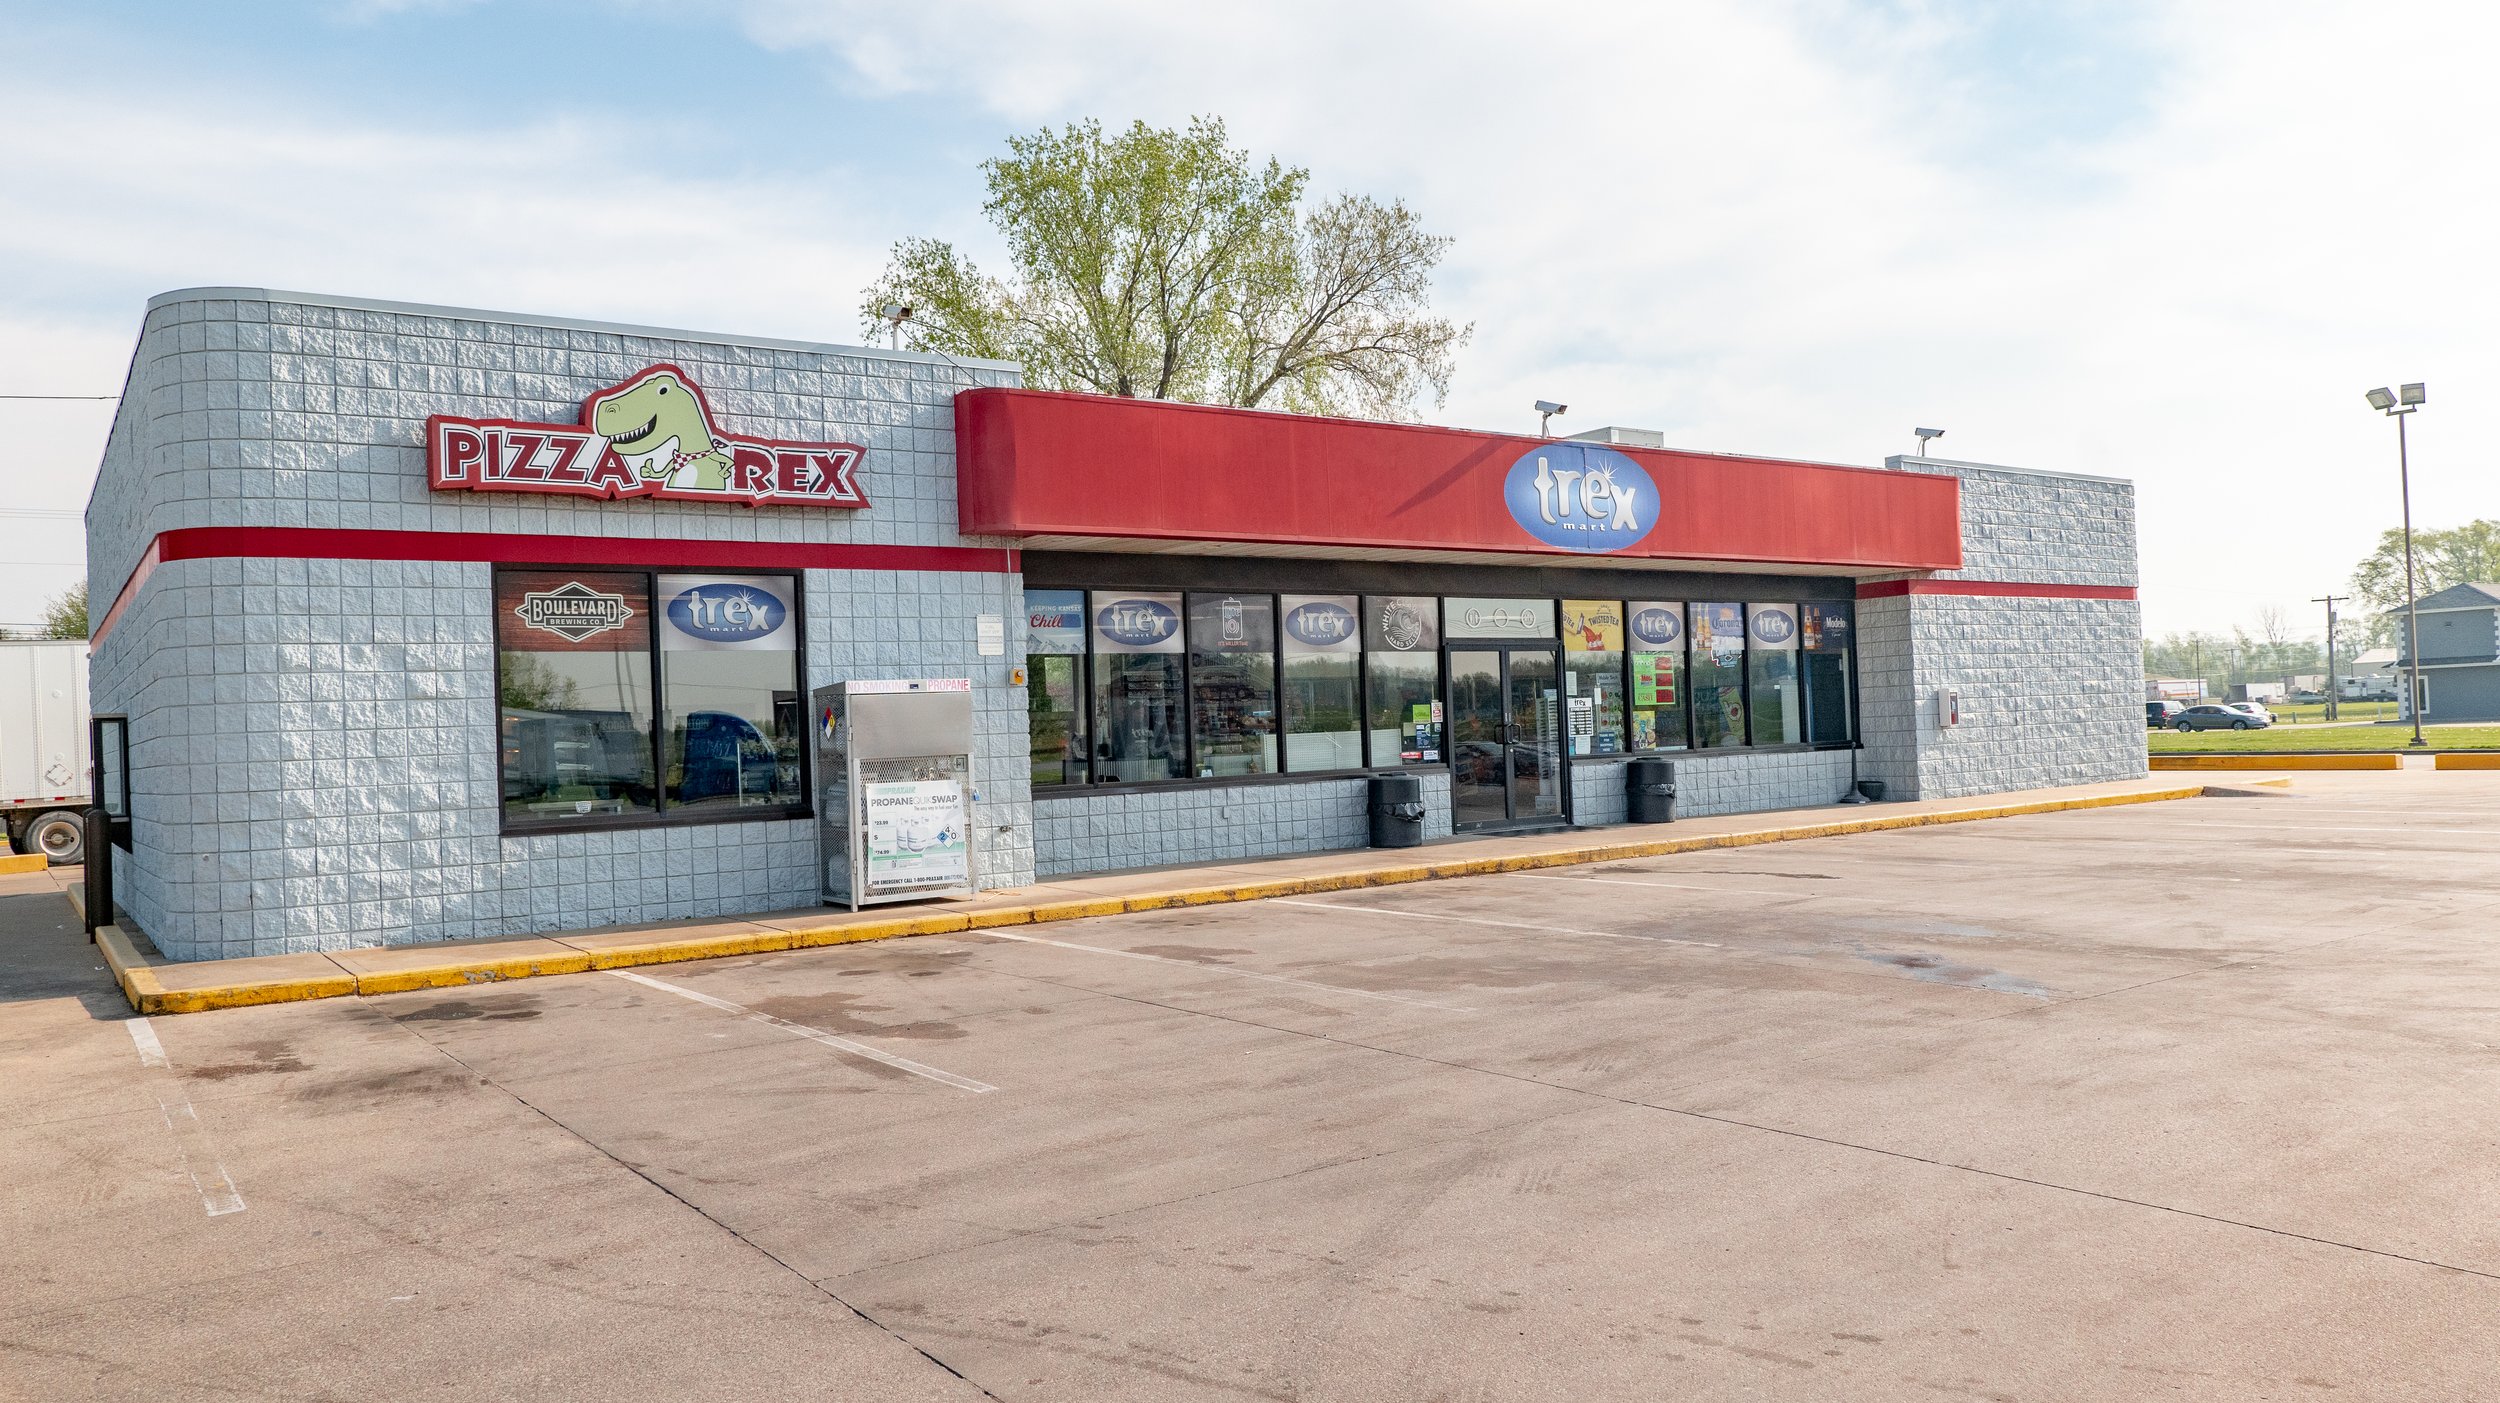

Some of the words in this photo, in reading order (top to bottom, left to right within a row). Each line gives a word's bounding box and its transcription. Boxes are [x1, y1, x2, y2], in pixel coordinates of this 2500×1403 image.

[445, 429, 638, 488] PIZZA
[732, 447, 855, 496] REX
[1534, 457, 1638, 531] trex
[1563, 523, 1606, 531] mart
[533, 599, 617, 622] BOULEVARD
[688, 591, 769, 631] trex
[1382, 601, 1396, 632] WHITE
[1030, 613, 1063, 628] Chill
[1111, 605, 1166, 636] trex
[1297, 607, 1346, 637] trex
[1588, 615, 1610, 626] TWISTED
[1610, 615, 1619, 627] TEA
[1640, 613, 1674, 637] trex
[1712, 616, 1741, 631] Corona
[1758, 614, 1788, 637] trex
[1826, 616, 1846, 628] Modelo
[1390, 635, 1404, 647] HARD
[847, 682, 861, 693] NO
[863, 680, 909, 692] SMOKING
[928, 679, 969, 692] PROPANE
[1574, 699, 1587, 707] trex
[940, 832, 946, 840] 2
